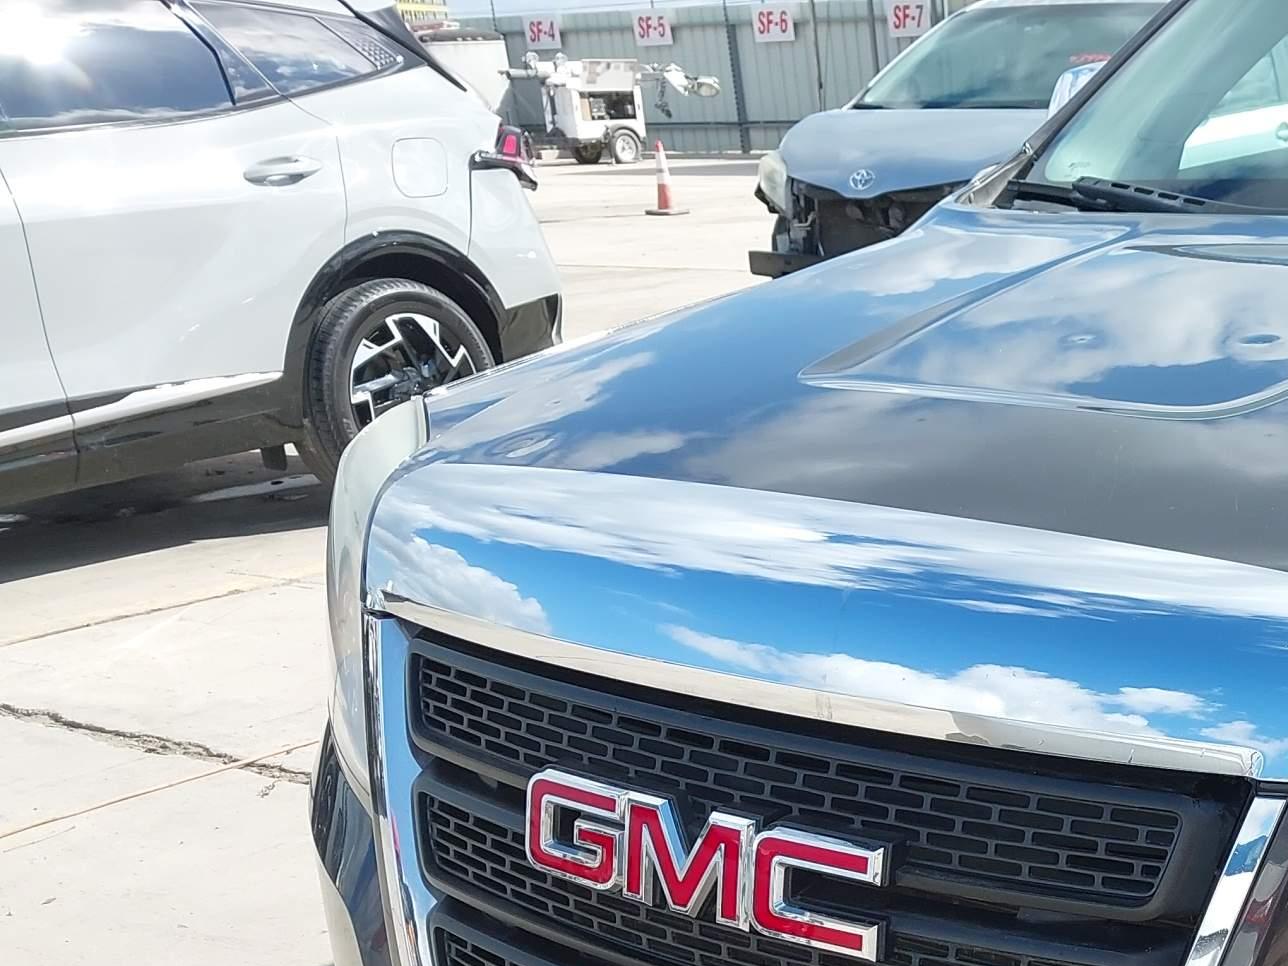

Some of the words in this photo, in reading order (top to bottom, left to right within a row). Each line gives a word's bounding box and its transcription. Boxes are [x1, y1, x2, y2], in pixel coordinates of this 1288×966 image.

[638, 16, 665, 38] SF-5
[758, 10, 788, 34] SF-6
[893, 5, 923, 29] SF-7
[529, 21, 556, 42] SF-4
[525, 768, 884, 962] GMC
